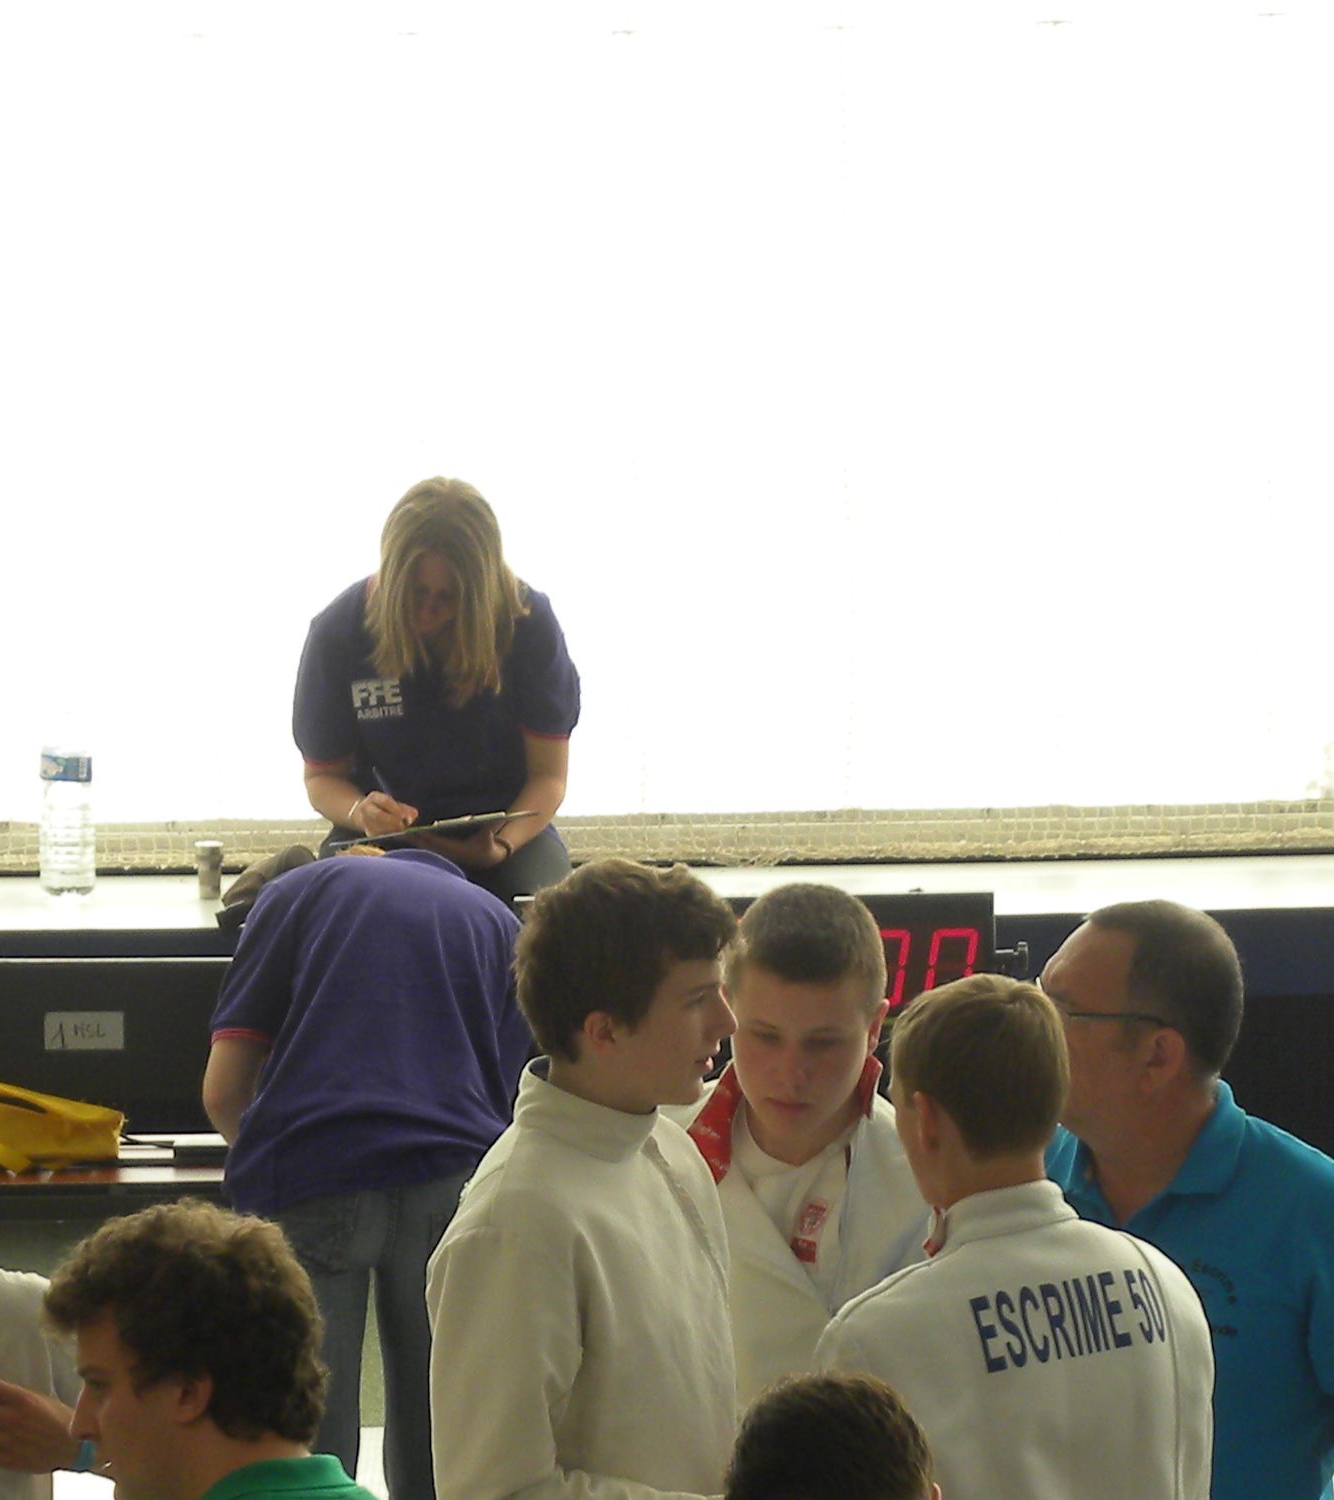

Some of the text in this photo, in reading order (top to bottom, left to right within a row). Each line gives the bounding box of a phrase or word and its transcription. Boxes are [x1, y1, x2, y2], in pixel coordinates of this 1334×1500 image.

[351, 679, 403, 708] FFE
[357, 704, 404, 720] ARBITRE
[969, 1268, 1166, 1374] ESCRIME 50
